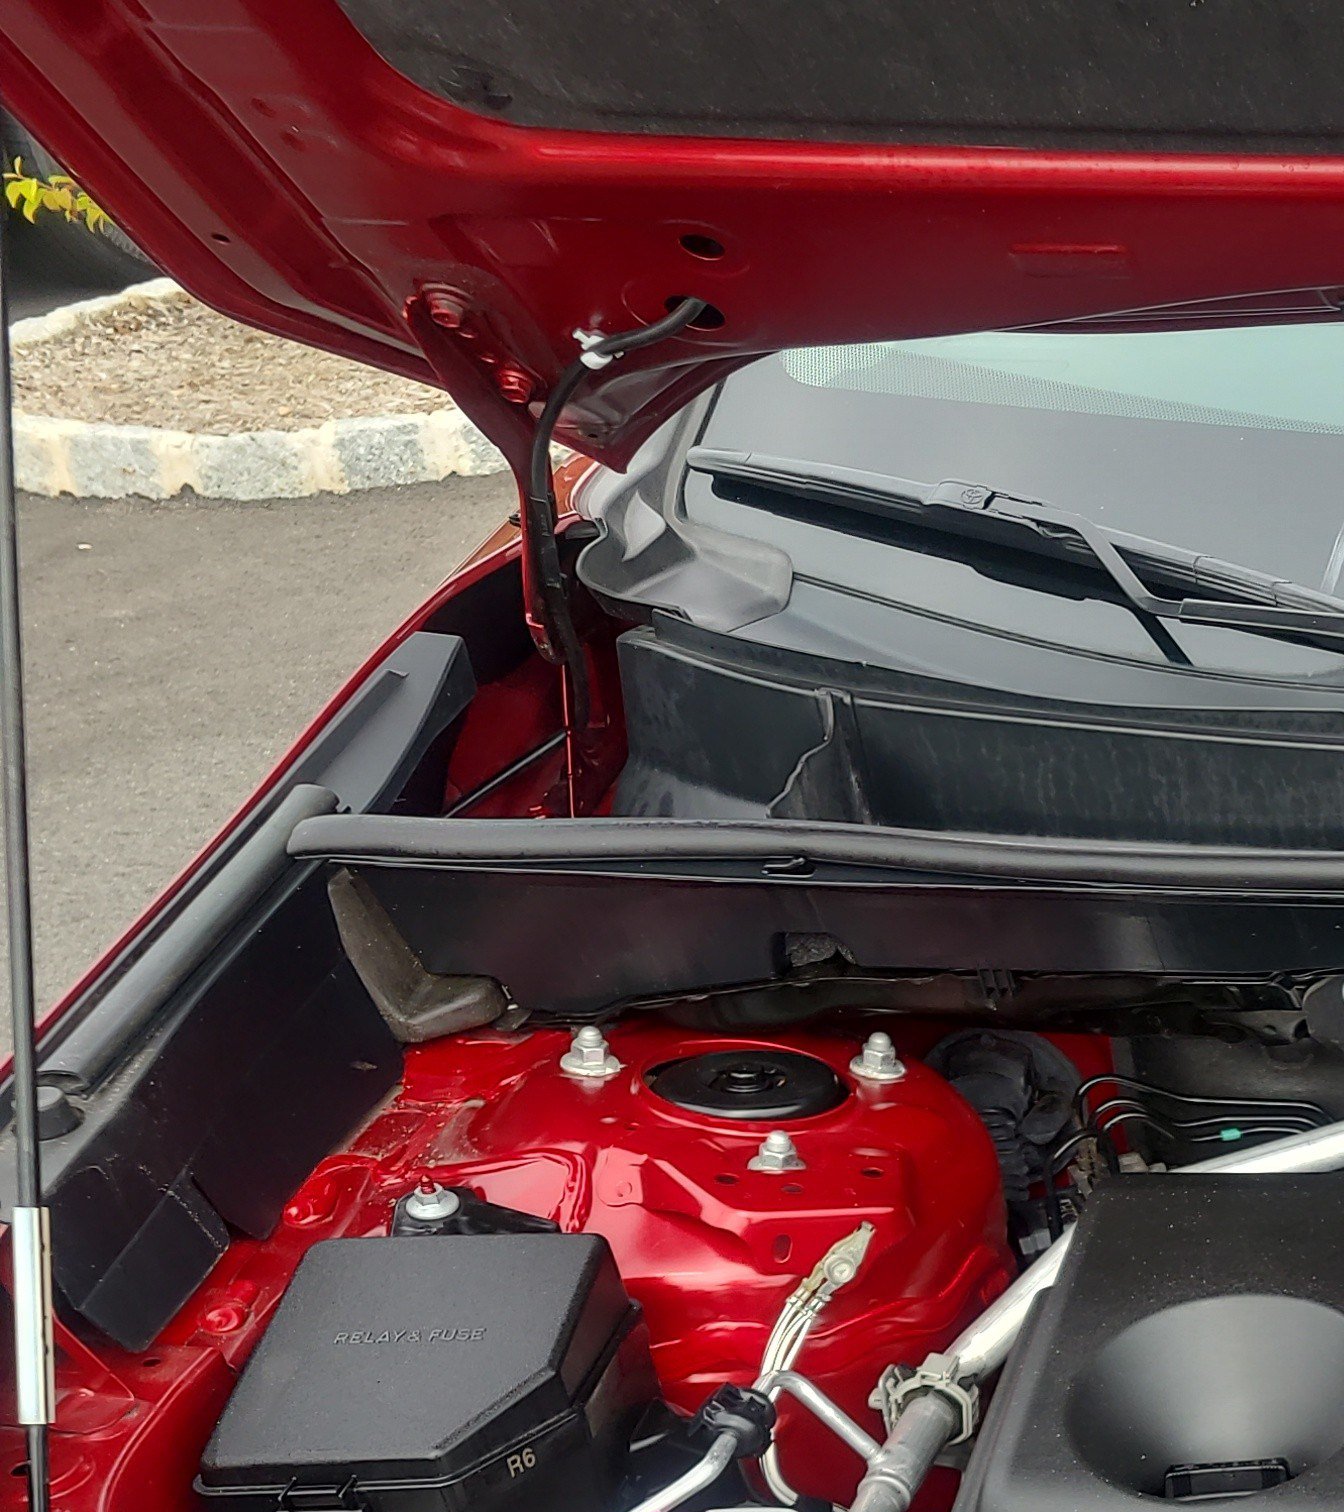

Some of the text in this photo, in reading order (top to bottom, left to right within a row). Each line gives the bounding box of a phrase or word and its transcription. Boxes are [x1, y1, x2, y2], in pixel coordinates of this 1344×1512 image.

[333, 1330, 407, 1345] RELAY
[428, 1328, 487, 1343] FUSE
[506, 1447, 536, 1479] R6
